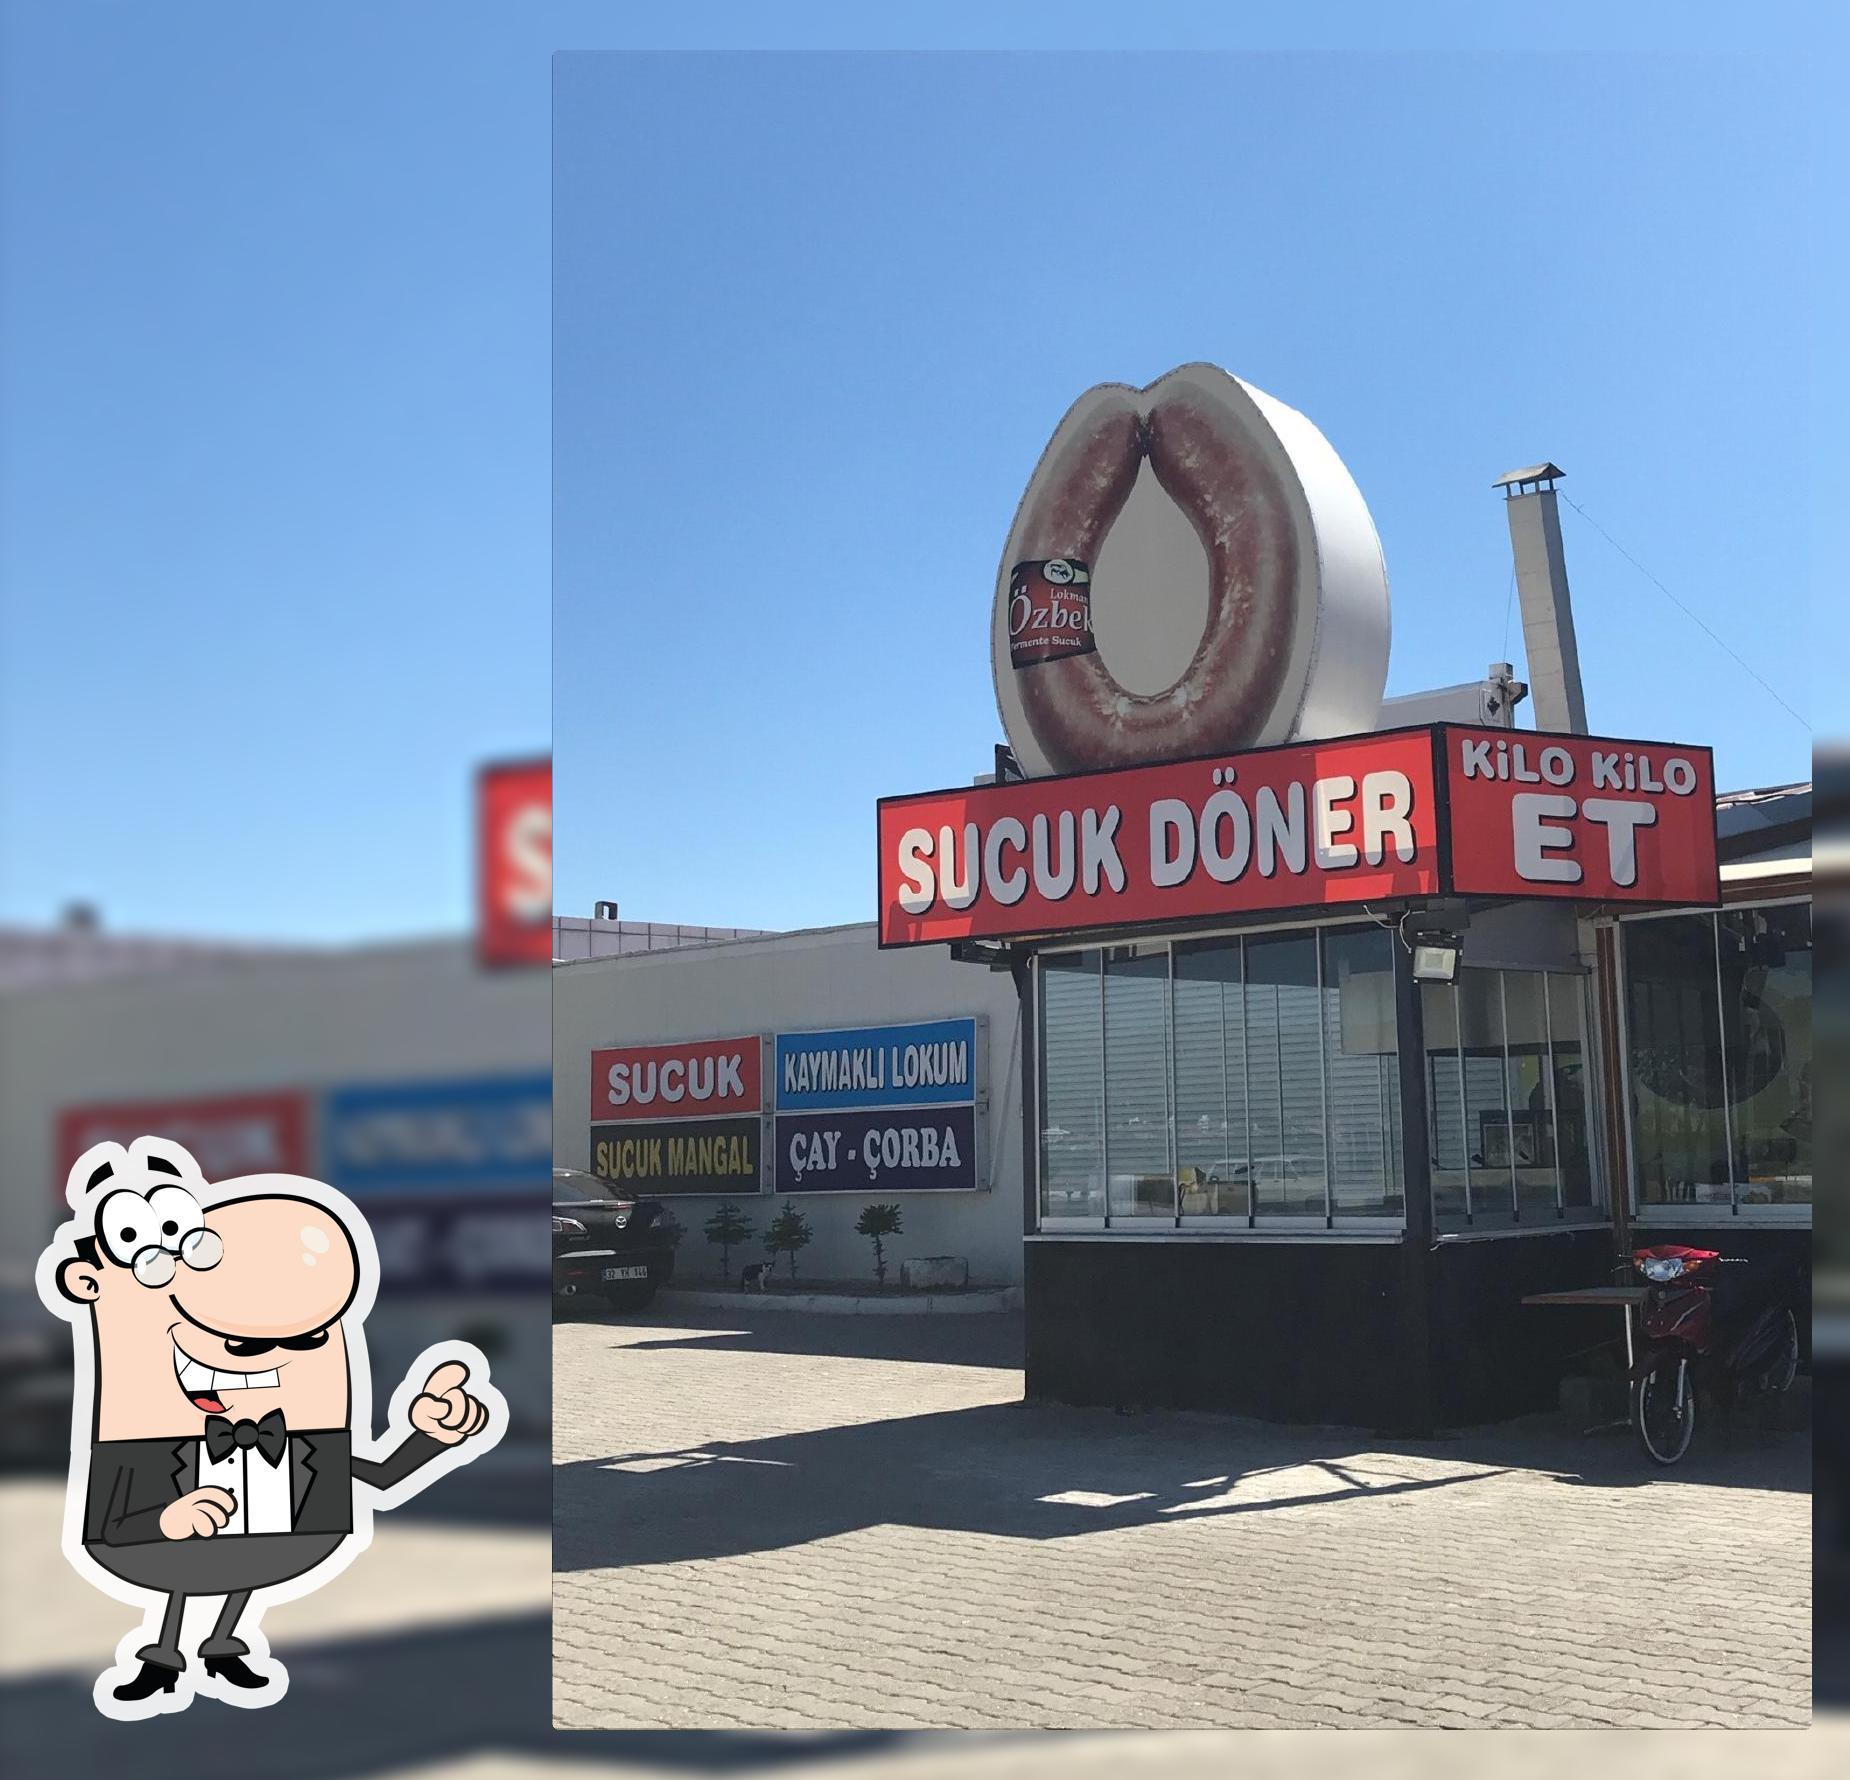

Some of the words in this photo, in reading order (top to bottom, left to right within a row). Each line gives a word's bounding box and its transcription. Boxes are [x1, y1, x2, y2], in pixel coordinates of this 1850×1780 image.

[1052, 635, 1082, 647] Sucuk
[899, 804, 1125, 914] SUCUK
[1150, 767, 1415, 888] DÖNER
[1512, 793, 1657, 887] ET
[608, 1054, 745, 1105] SUCUK
[785, 1047, 885, 1092] KAYMAKLI
[892, 1040, 968, 1088] LOKUM
[596, 1137, 662, 1180] SUCUK
[668, 1135, 753, 1176] MANGAL
[790, 1131, 841, 1182] ÇAY
[863, 1126, 961, 1180] ÇORBA
